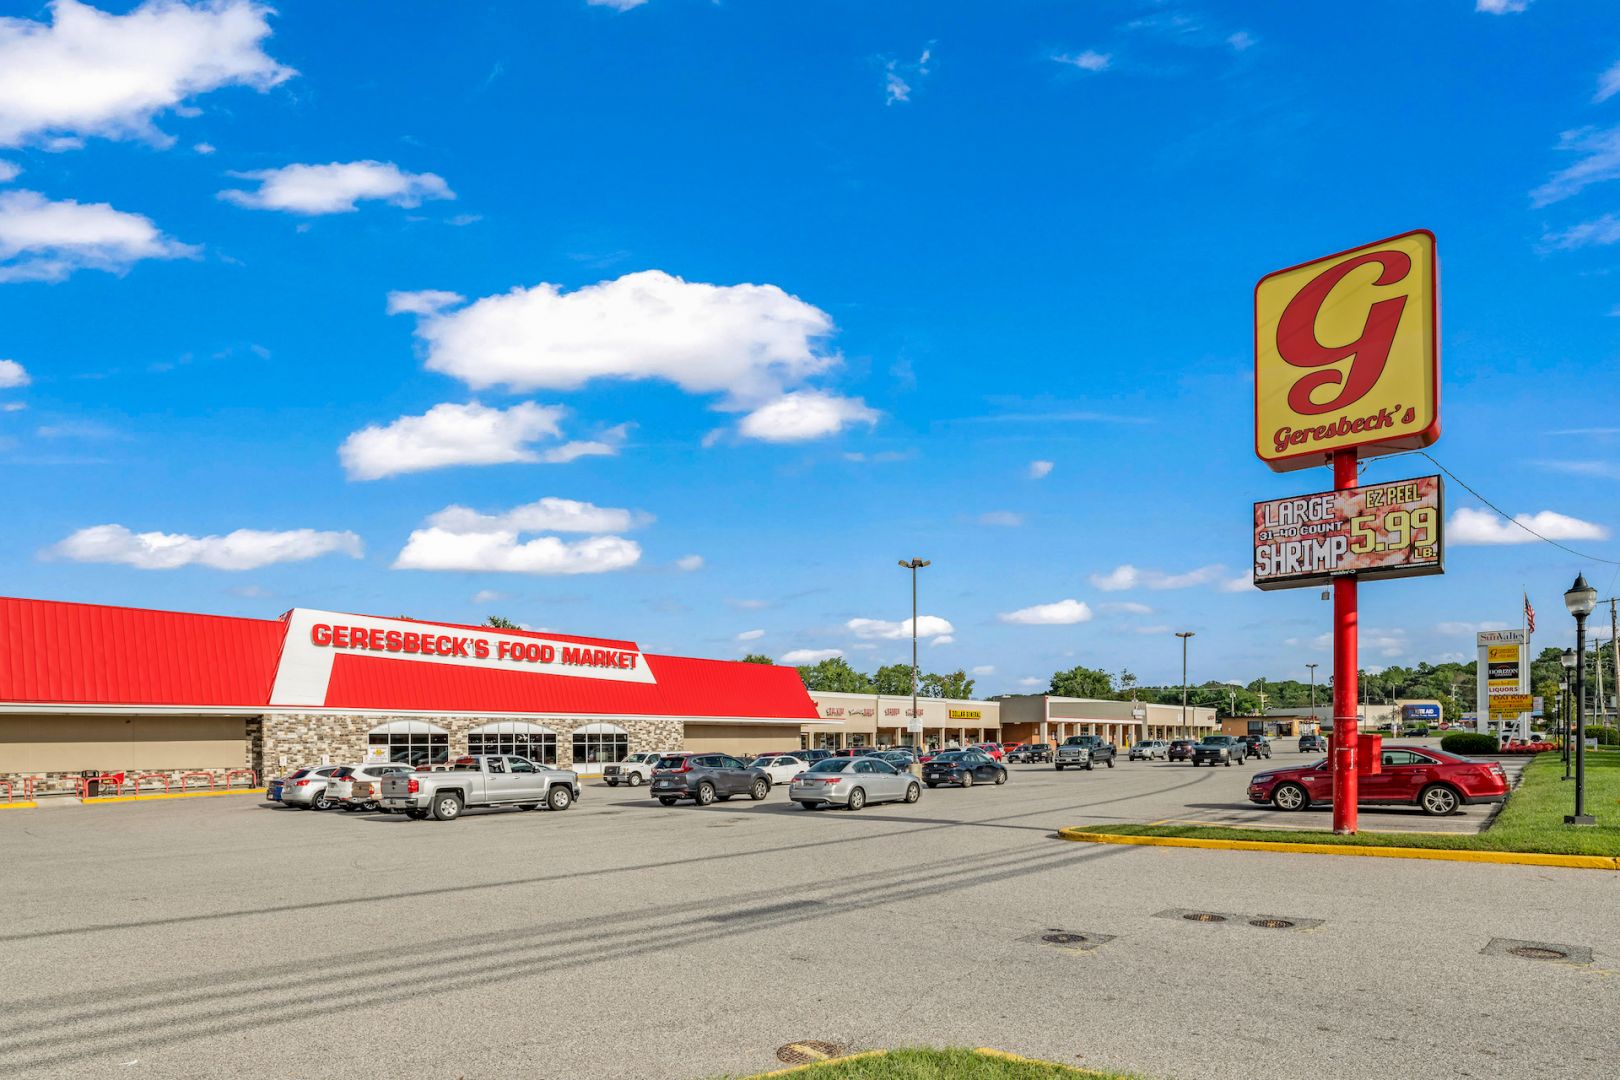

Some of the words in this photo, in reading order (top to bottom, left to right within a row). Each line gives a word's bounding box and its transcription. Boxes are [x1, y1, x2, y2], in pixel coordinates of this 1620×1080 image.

[1273, 404, 1416, 453] Geresbeck's
[1264, 495, 1336, 528] LARGE
[1365, 488, 1385, 509] EZ
[1387, 483, 1422, 506] PEEL
[1259, 526, 1298, 541] 31-40
[1300, 521, 1344, 536] COUNT
[1350, 506, 1438, 554] 5.99
[1255, 535, 1348, 577] SHRIMP
[311, 623, 490, 659] GERESBECK'S
[498, 640, 555, 664] FOOD
[562, 646, 639, 669] MARKET
